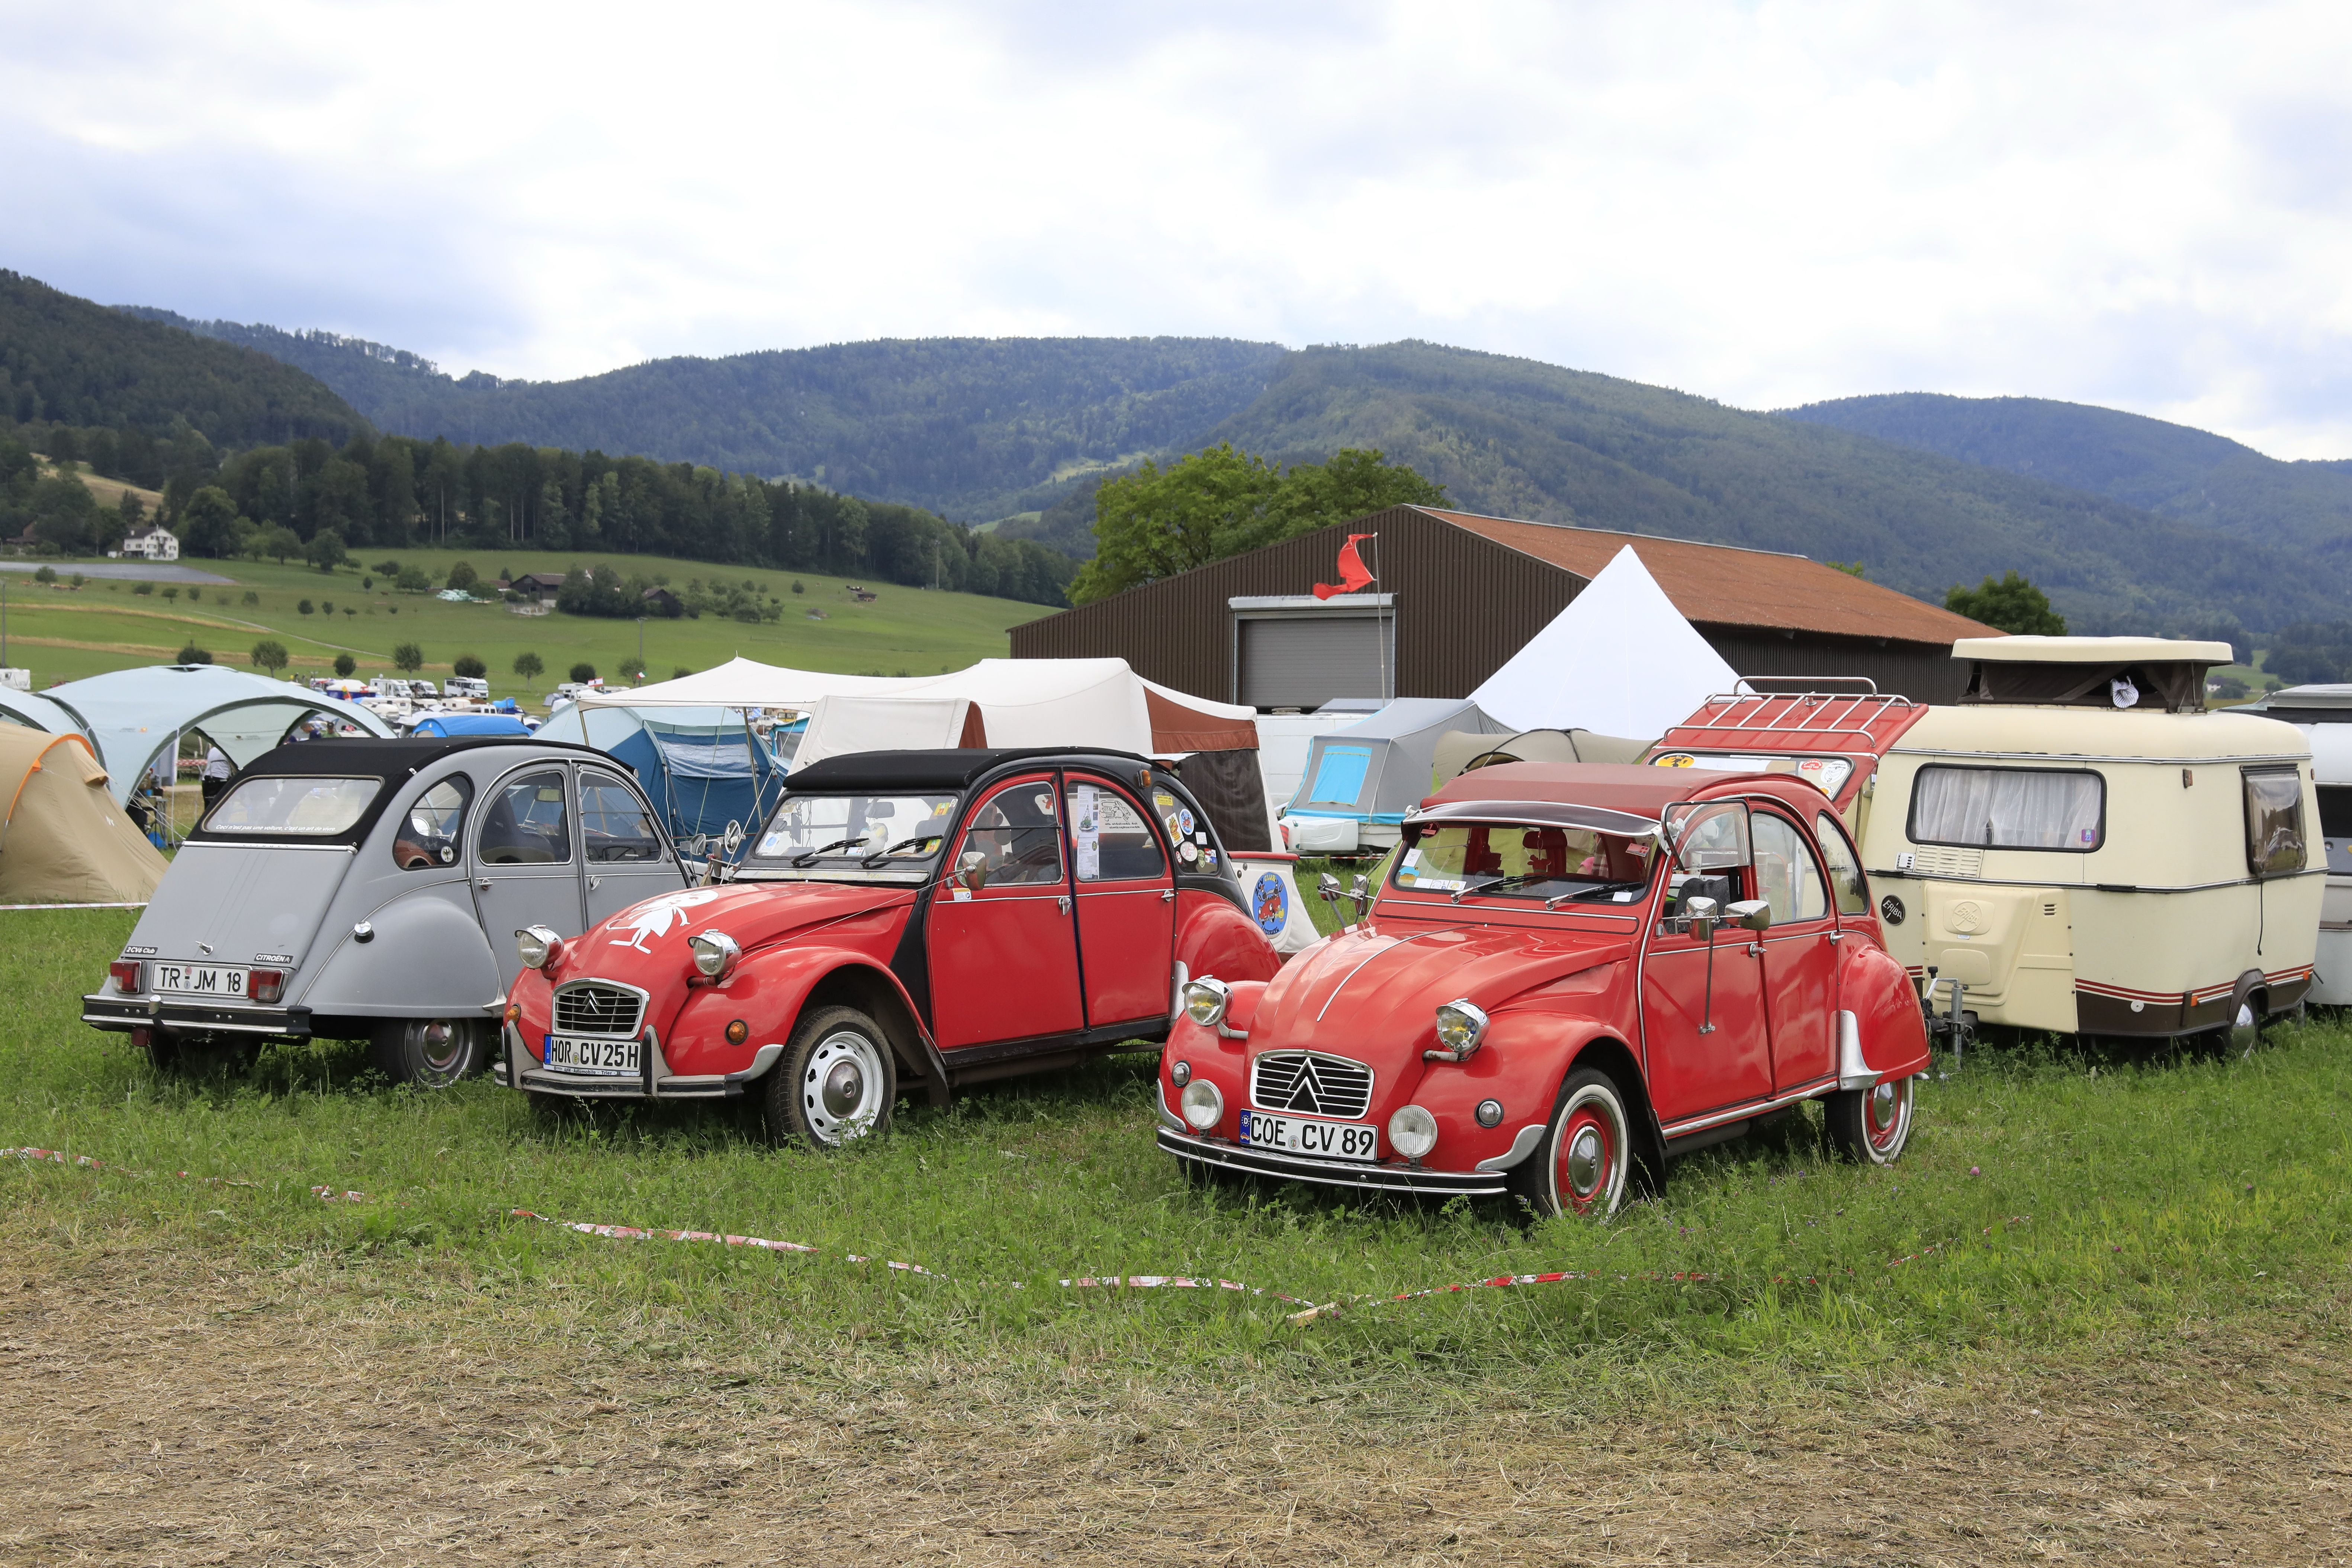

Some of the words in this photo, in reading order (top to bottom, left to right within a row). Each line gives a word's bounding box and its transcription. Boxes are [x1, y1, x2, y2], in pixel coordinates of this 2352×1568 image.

[1882, 900, 1902, 920] ERIBA
[1954, 906, 1978, 926] ERIBA
[161, 967, 180, 988] TR
[194, 970, 216, 991] JM
[227, 971, 241, 992] 18
[552, 1040, 571, 1063] HOR
[580, 1042, 601, 1065] CV
[1251, 1116, 1286, 1146] COE
[1302, 1124, 1335, 1151] CV
[1342, 1128, 1374, 1155] 89
